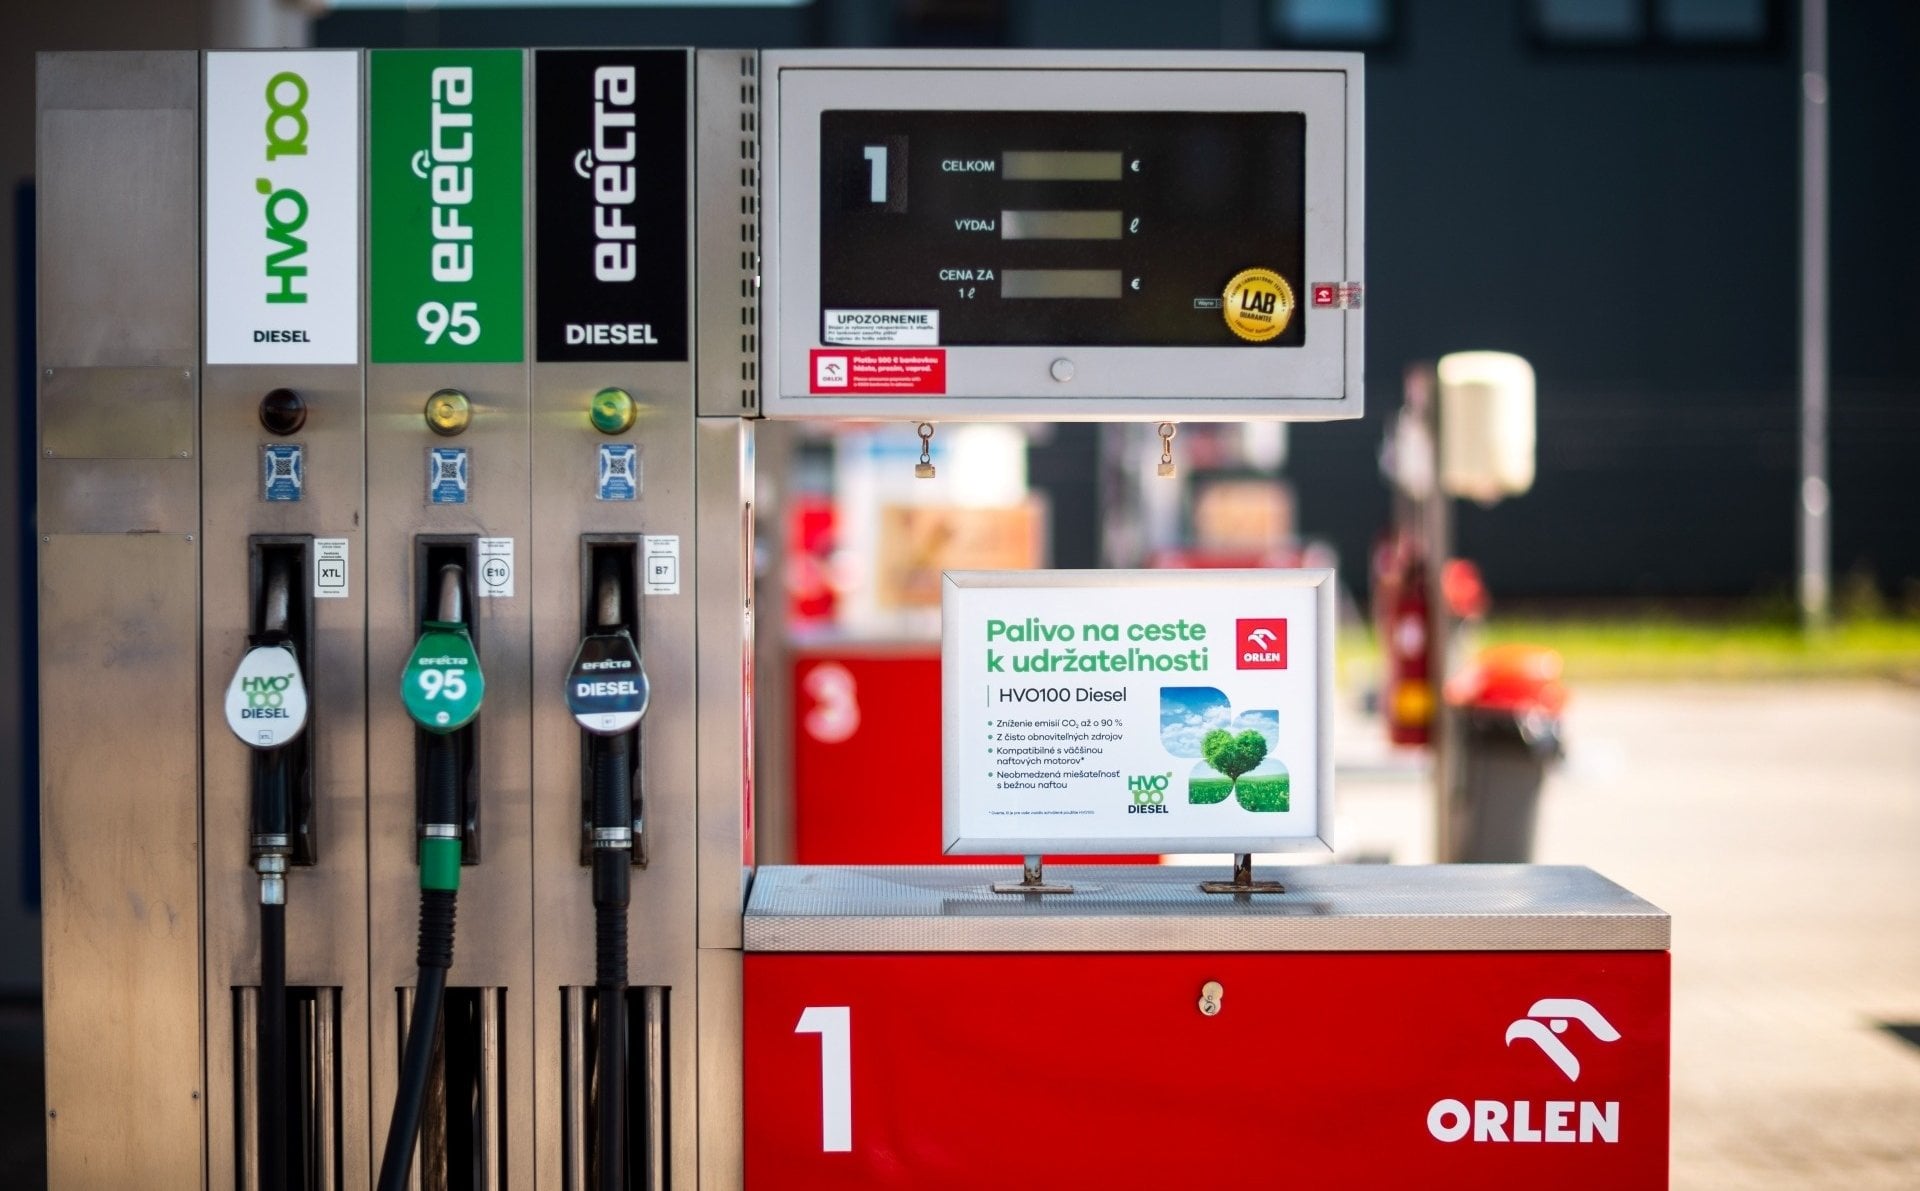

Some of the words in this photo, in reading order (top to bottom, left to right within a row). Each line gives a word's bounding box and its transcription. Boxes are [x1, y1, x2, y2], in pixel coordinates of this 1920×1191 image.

[265, 71, 309, 161] 100
[942, 160, 995, 172] CELKOM
[1131, 160, 1140, 172] €
[864, 146, 887, 203] 1
[955, 218, 995, 231] VÝDAJ
[265, 188, 309, 303] HVO
[939, 270, 973, 281] CENA
[976, 270, 994, 281] ZA
[1131, 278, 1140, 290] €
[958, 288, 965, 298] 1
[1241, 288, 1276, 315] LAB
[416, 301, 481, 345] 95
[837, 315, 928, 324] UPOZORNENIE
[253, 330, 311, 343] DIESEL
[566, 324, 658, 345] DIESEL
[322, 569, 341, 578] XTL
[487, 568, 505, 577] E10
[656, 566, 668, 575] B7
[987, 617, 1075, 642] Palivo
[1082, 623, 1119, 642] na
[1127, 619, 1207, 641] ceste
[987, 648, 1005, 672] k
[1012, 647, 1208, 673] udržateľnosti
[1243, 652, 1281, 662] ORLEN
[242, 676, 290, 691] HVO
[418, 668, 467, 701] 95
[577, 681, 639, 697] DIESEL
[246, 691, 283, 708] 100
[1000, 687, 1071, 702] HVO100
[1076, 686, 1127, 702] Diesel
[802, 662, 861, 743] 3
[241, 708, 290, 719] DIESEL
[996, 719, 1033, 728] Zníženie
[1034, 719, 1060, 727] emisií
[1080, 719, 1091, 727] až
[1101, 719, 1113, 727] 90
[1114, 719, 1123, 727] %
[996, 733, 1003, 741] Z
[1004, 732, 1026, 741] čisto
[1027, 732, 1089, 742] obnoviteľných
[1091, 732, 1123, 742] zdrojov
[996, 746, 1055, 756] Kompatibilné
[1063, 746, 1103, 754] väčšinou
[996, 756, 1042, 766] naftových
[996, 770, 1061, 778] Neobmedzená
[1063, 769, 1120, 778] miešateľnosť
[1003, 781, 1036, 789] bežnou
[1038, 781, 1068, 789] naftou
[1128, 775, 1169, 790] HVO
[1132, 790, 1164, 805] 100
[1128, 805, 1169, 814] DIESEL
[794, 1005, 852, 1153] 1
[1426, 1098, 1620, 1144] ORLEN
